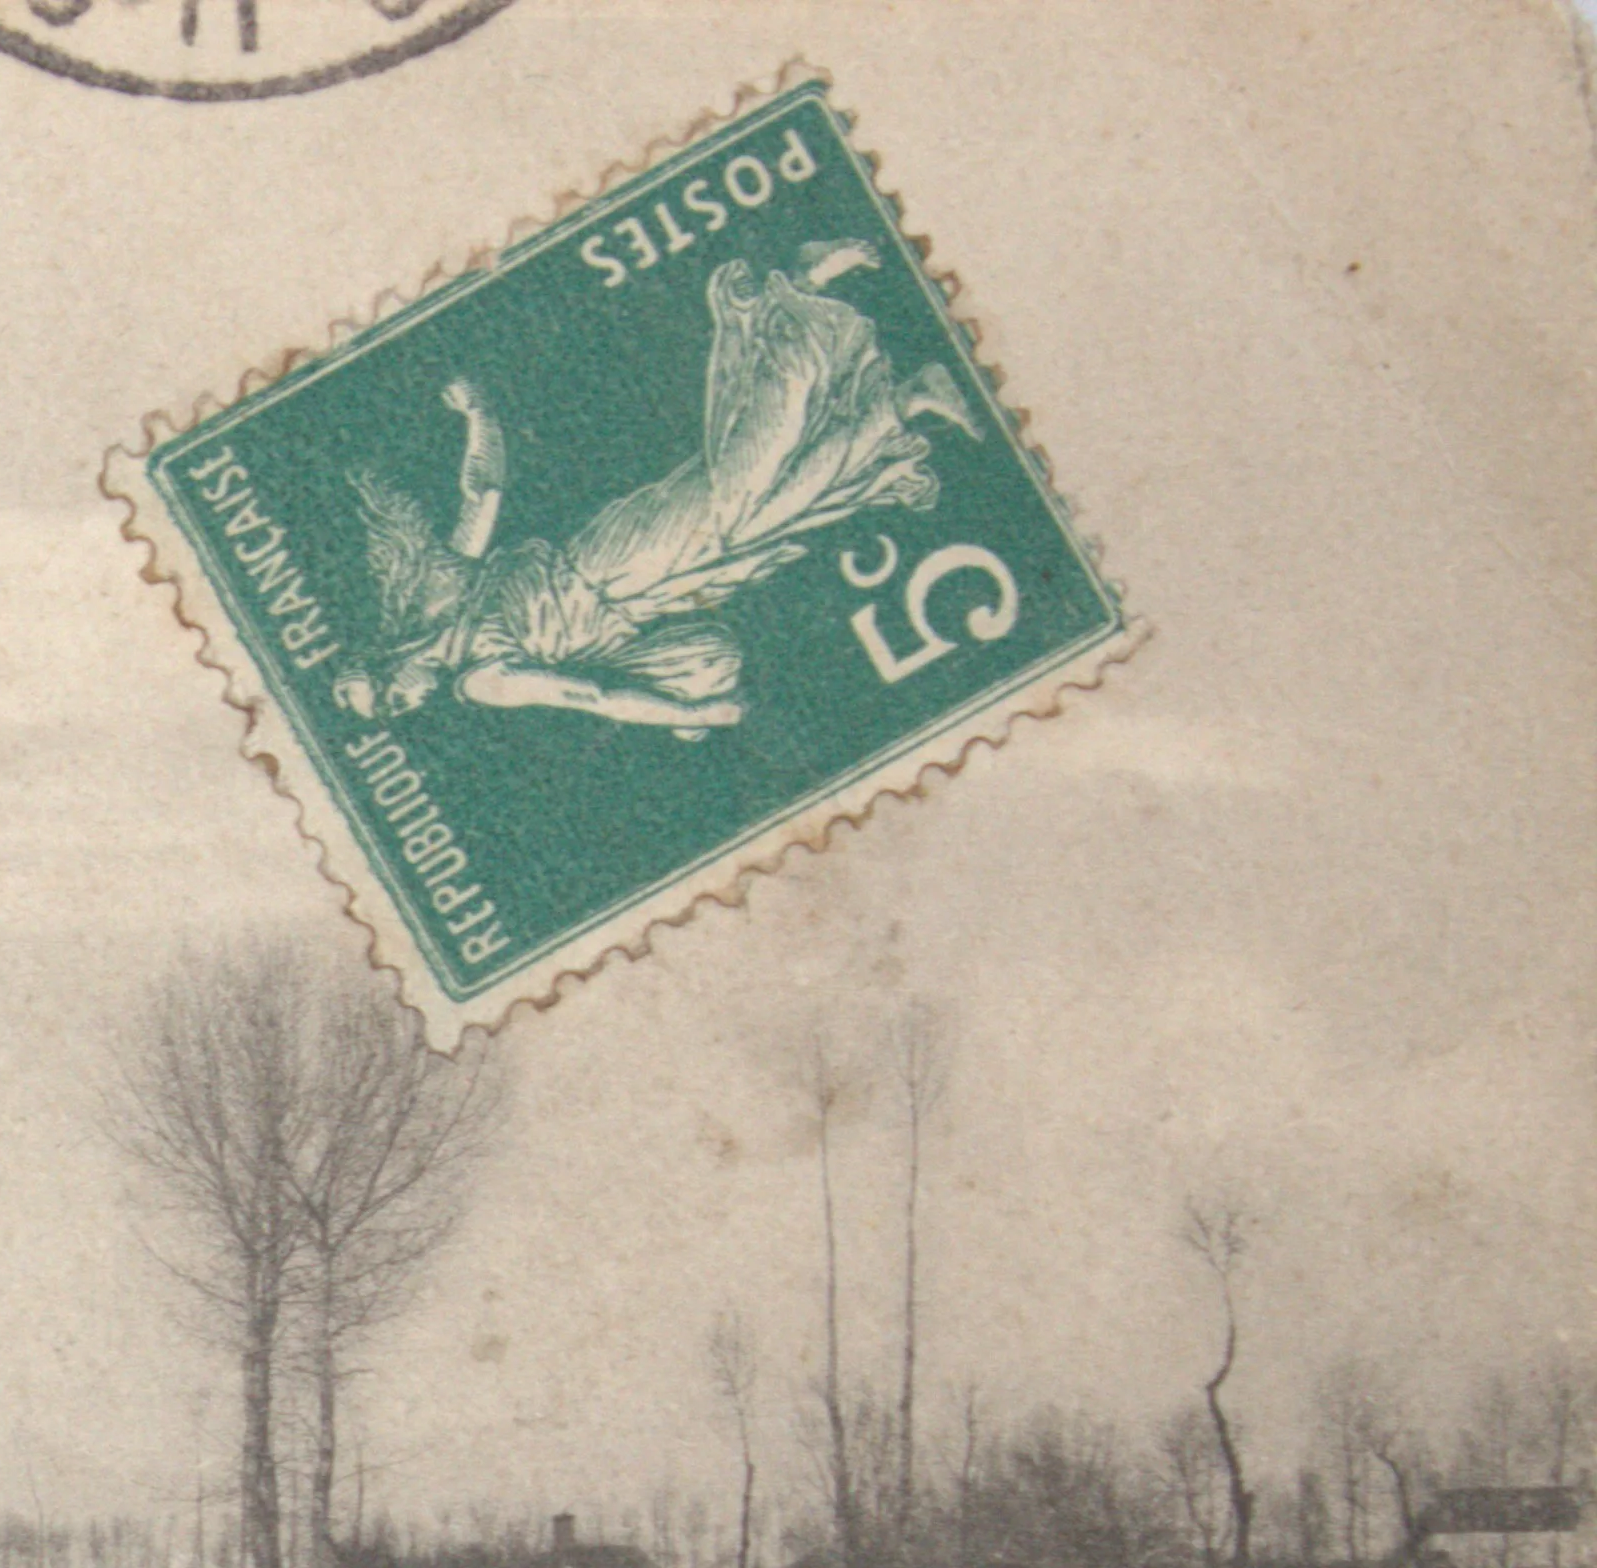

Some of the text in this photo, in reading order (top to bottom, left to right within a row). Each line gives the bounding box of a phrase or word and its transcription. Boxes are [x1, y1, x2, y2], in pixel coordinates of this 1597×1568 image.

[580, 127, 818, 288] POSTES
[188, 445, 511, 964] REPUBLIQUE FRANÇAISE
